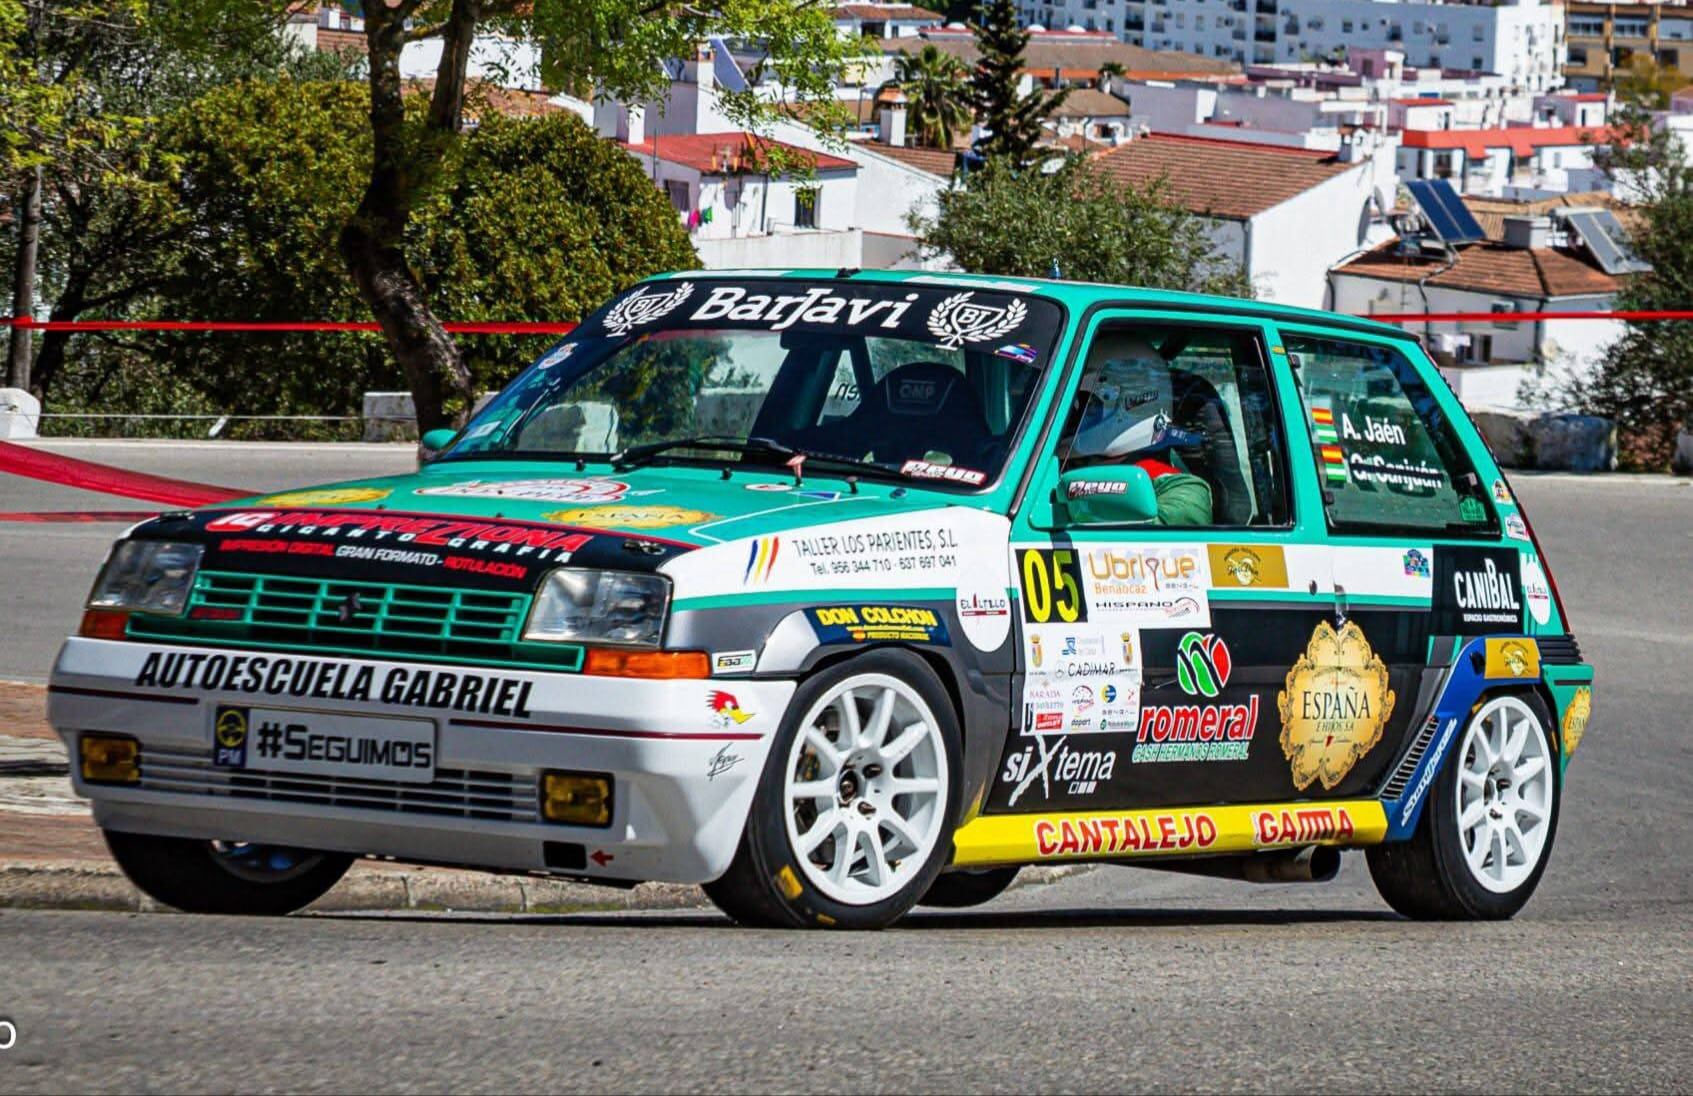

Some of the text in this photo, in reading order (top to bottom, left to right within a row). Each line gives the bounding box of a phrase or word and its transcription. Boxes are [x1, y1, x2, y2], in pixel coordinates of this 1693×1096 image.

[689, 286, 919, 331] BarJavi
[1342, 412, 1406, 445] A. Jaén
[335, 544, 374, 561] GRAN
[792, 537, 841, 558] TALLER
[842, 534, 866, 554] LOS
[867, 529, 936, 551] PARIENTES,
[831, 561, 851, 575] 956
[852, 560, 871, 574] 344
[872, 558, 892, 572] 710
[938, 555, 958, 568] 041
[1023, 549, 1080, 622] 05
[816, 607, 938, 627] DON COLCHON
[1095, 600, 1174, 608] HISPANO
[135, 652, 534, 718] AUTOESCUELA GABRIEL
[1136, 694, 1259, 742] romeral
[1302, 686, 1371, 720] ESPAÑA
[1132, 741, 1250, 764] CASH HERMANOS ROMERAL
[1034, 812, 1218, 857] CANTALEJO
